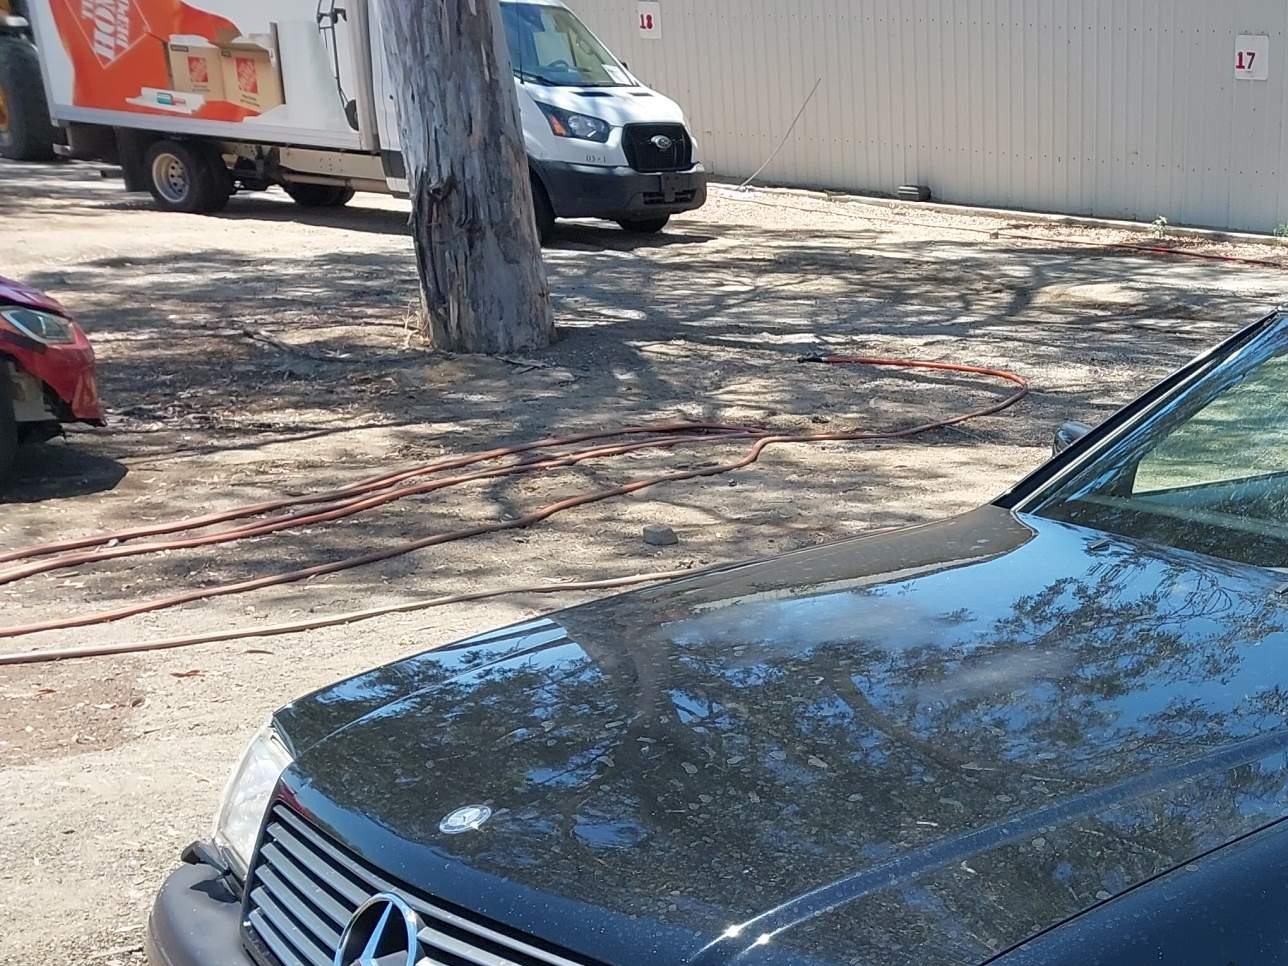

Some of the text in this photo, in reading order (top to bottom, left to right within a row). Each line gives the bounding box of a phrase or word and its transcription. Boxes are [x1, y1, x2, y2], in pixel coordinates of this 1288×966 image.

[93, 0, 115, 61] HO
[640, 13, 654, 30] 18
[1236, 51, 1256, 70] 17
